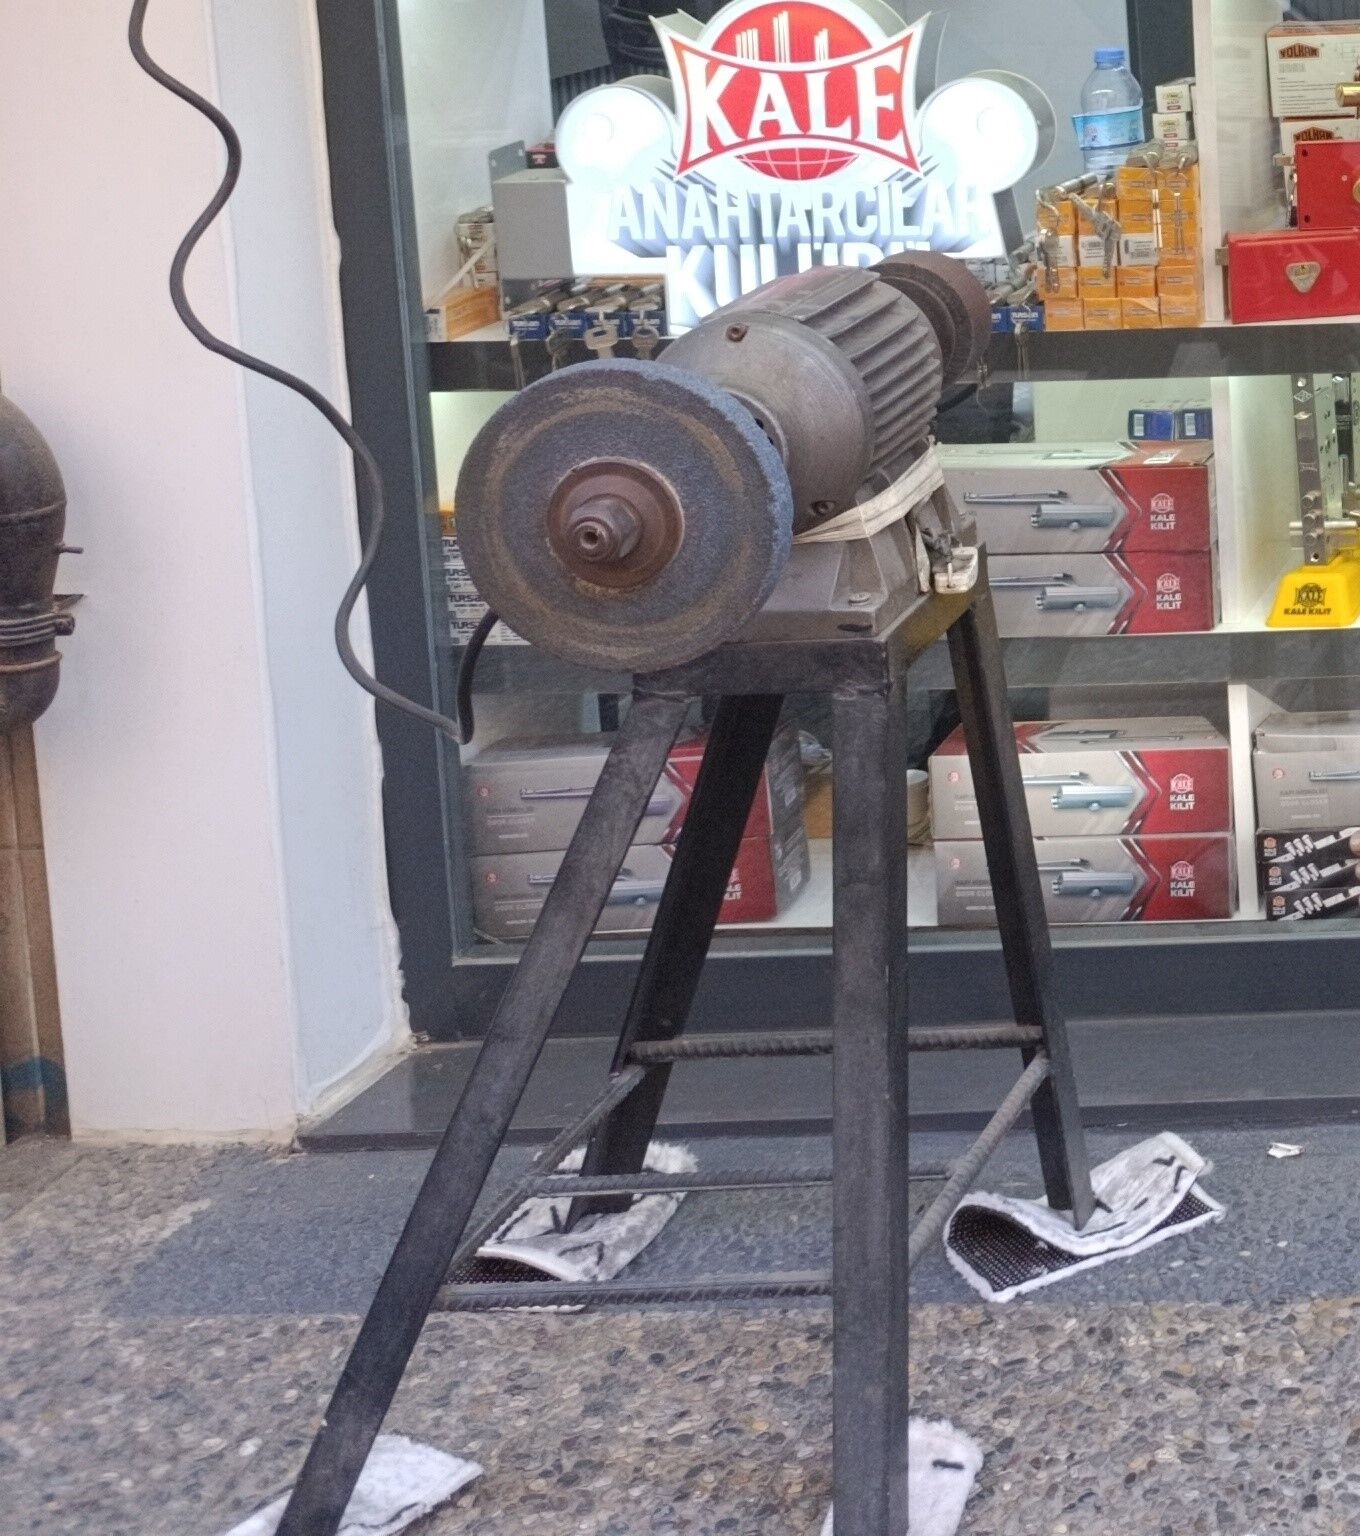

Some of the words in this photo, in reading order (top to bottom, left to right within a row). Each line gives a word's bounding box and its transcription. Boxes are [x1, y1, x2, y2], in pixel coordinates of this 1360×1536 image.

[681, 50, 906, 162] KALE
[608, 179, 994, 242] ANAHTARCILAR
[1150, 514, 1176, 522] KALE
[1156, 593, 1182, 601] KALE
[1283, 607, 1306, 615] KALE
[1169, 794, 1195, 802] KALE
[1170, 881, 1195, 889] KALE
